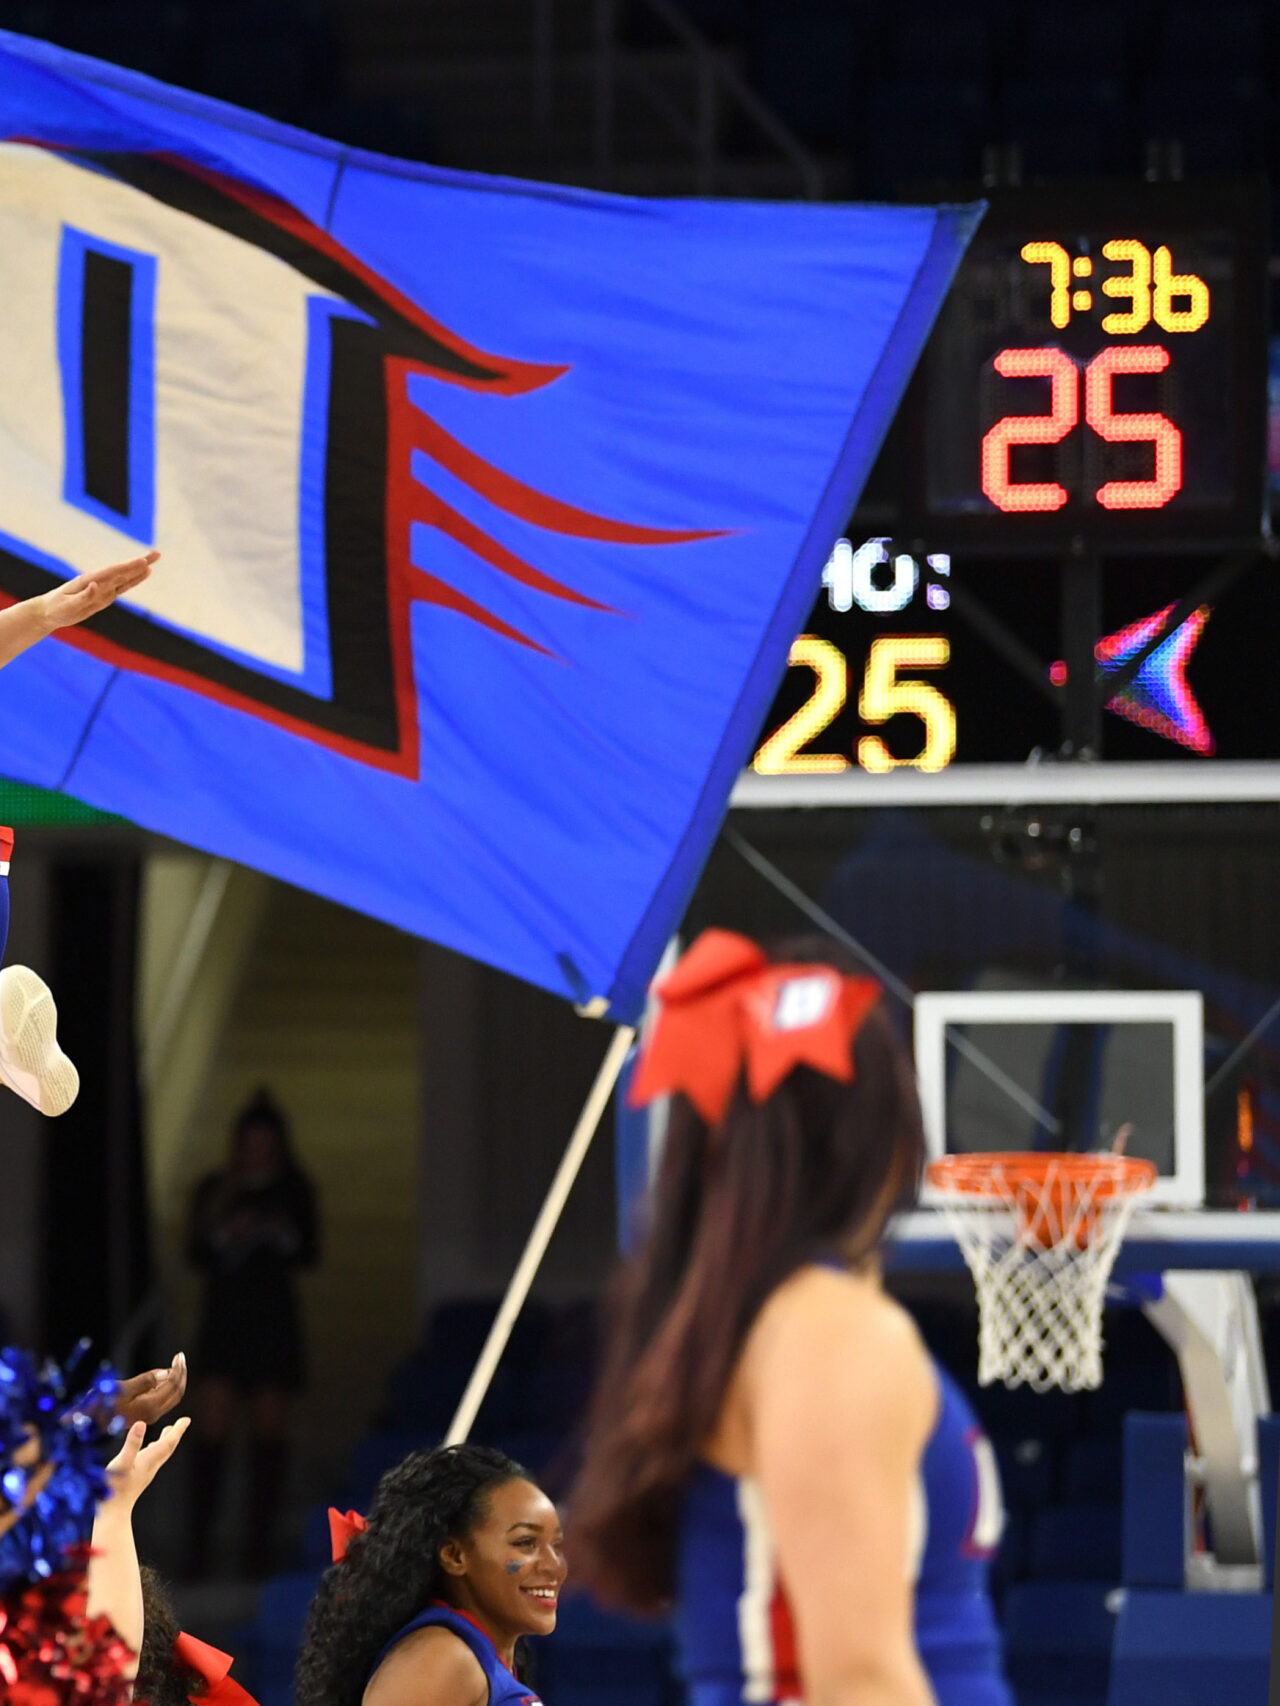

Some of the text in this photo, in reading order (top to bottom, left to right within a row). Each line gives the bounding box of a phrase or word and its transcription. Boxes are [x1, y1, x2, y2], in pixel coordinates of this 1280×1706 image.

[1020, 239, 1210, 334] 7:36
[982, 345, 1182, 512] 25
[753, 634, 958, 774] 25
